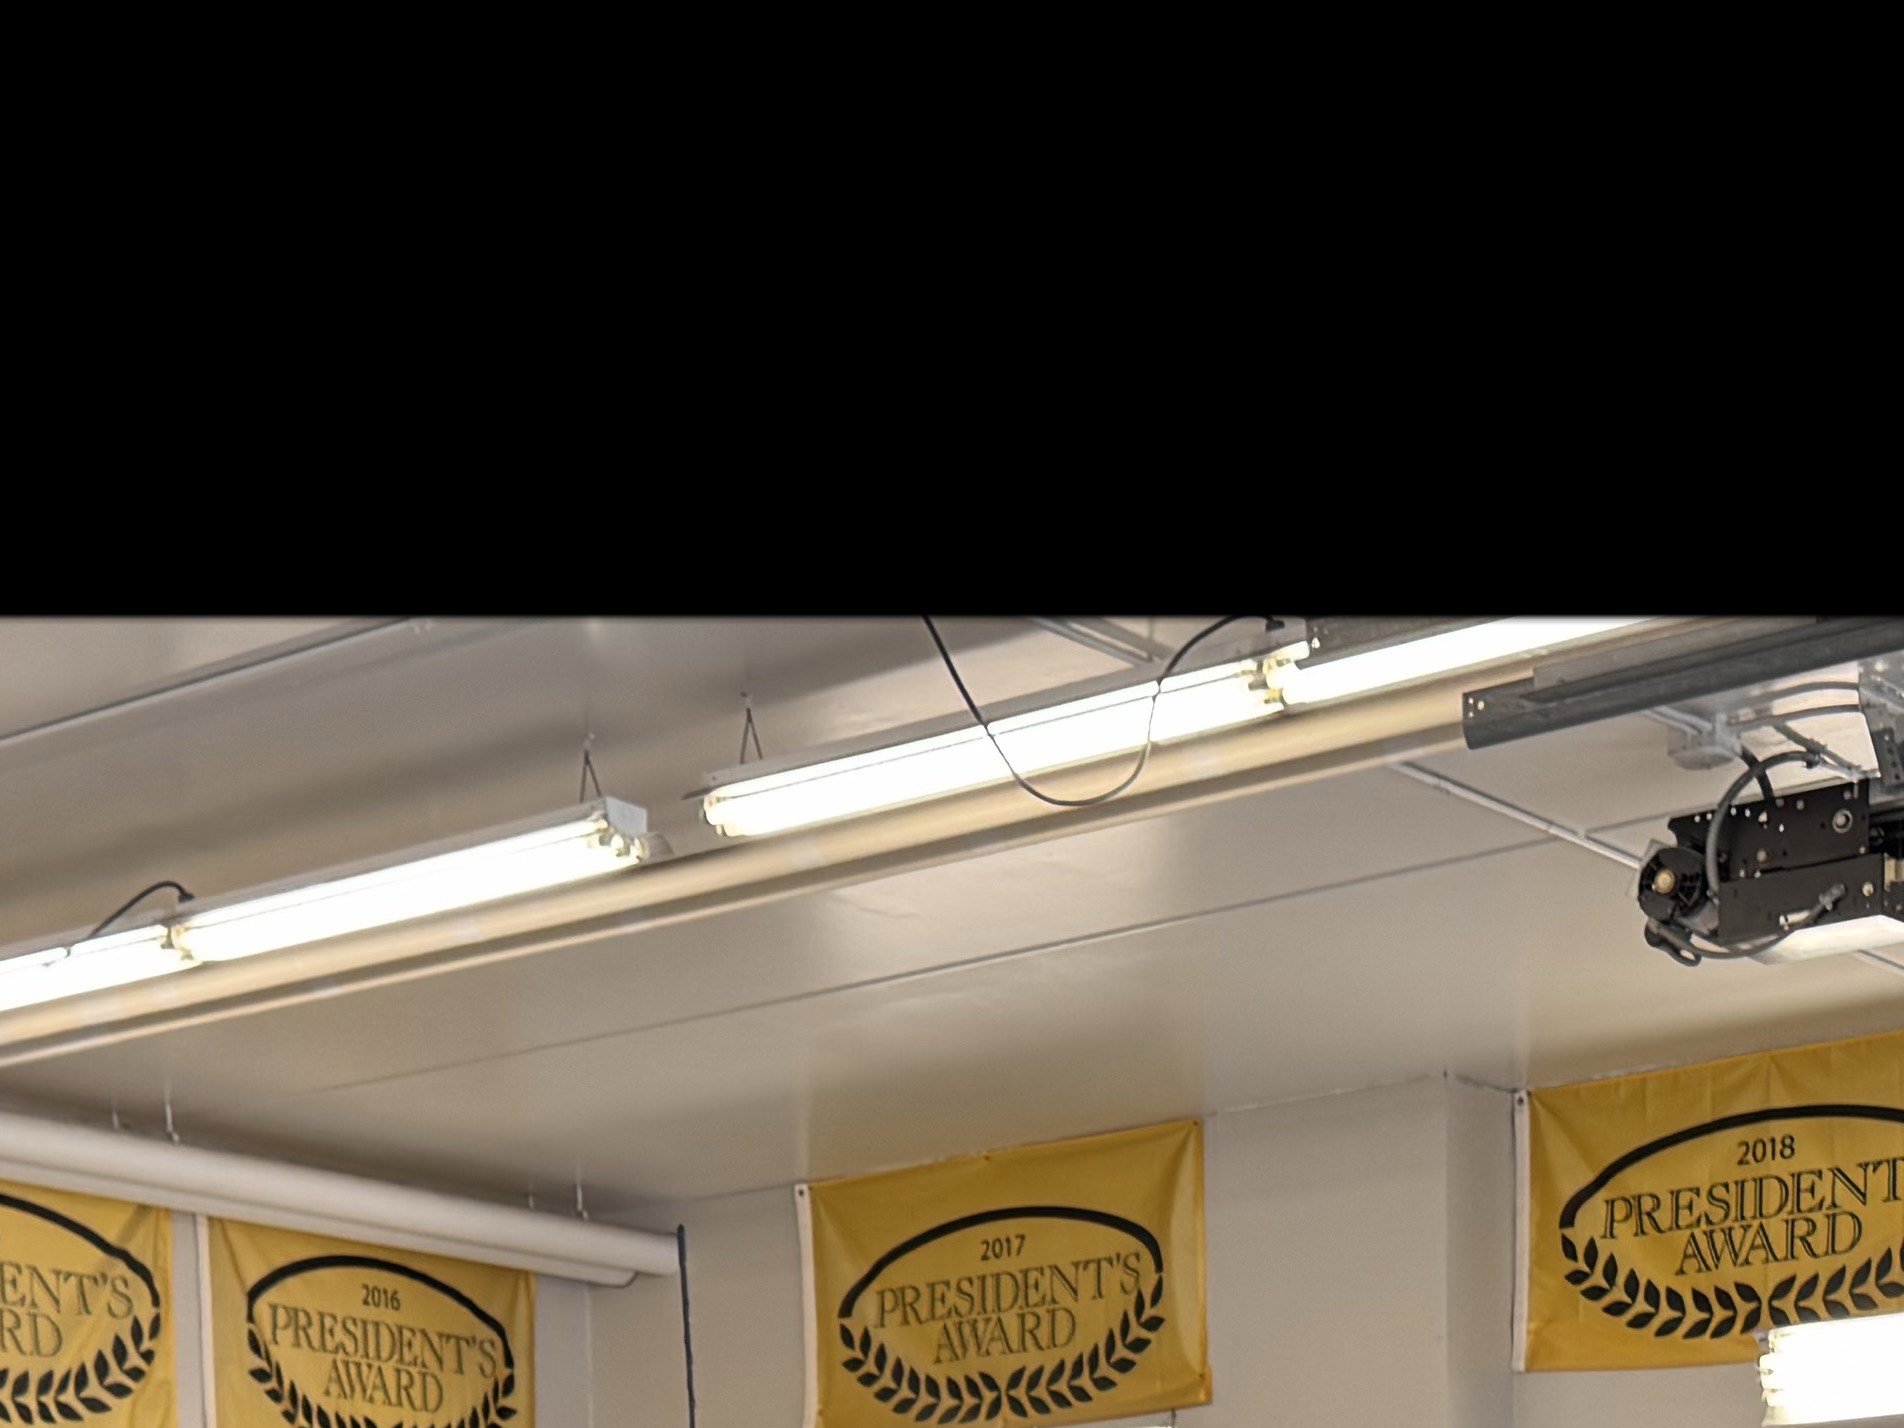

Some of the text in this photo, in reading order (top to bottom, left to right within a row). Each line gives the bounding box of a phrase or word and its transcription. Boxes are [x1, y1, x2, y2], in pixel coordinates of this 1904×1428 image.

[1737, 1134, 1796, 1167] 2018
[979, 1233, 1026, 1262] 2017
[1674, 1211, 1864, 1276] AWARD
[361, 1283, 401, 1312] 2016
[872, 1250, 1143, 1329] PRESIDENT'S
[266, 1302, 499, 1379] PRESIDENT'S
[933, 1306, 1078, 1365] AWARD
[322, 1358, 445, 1413] AWARD
